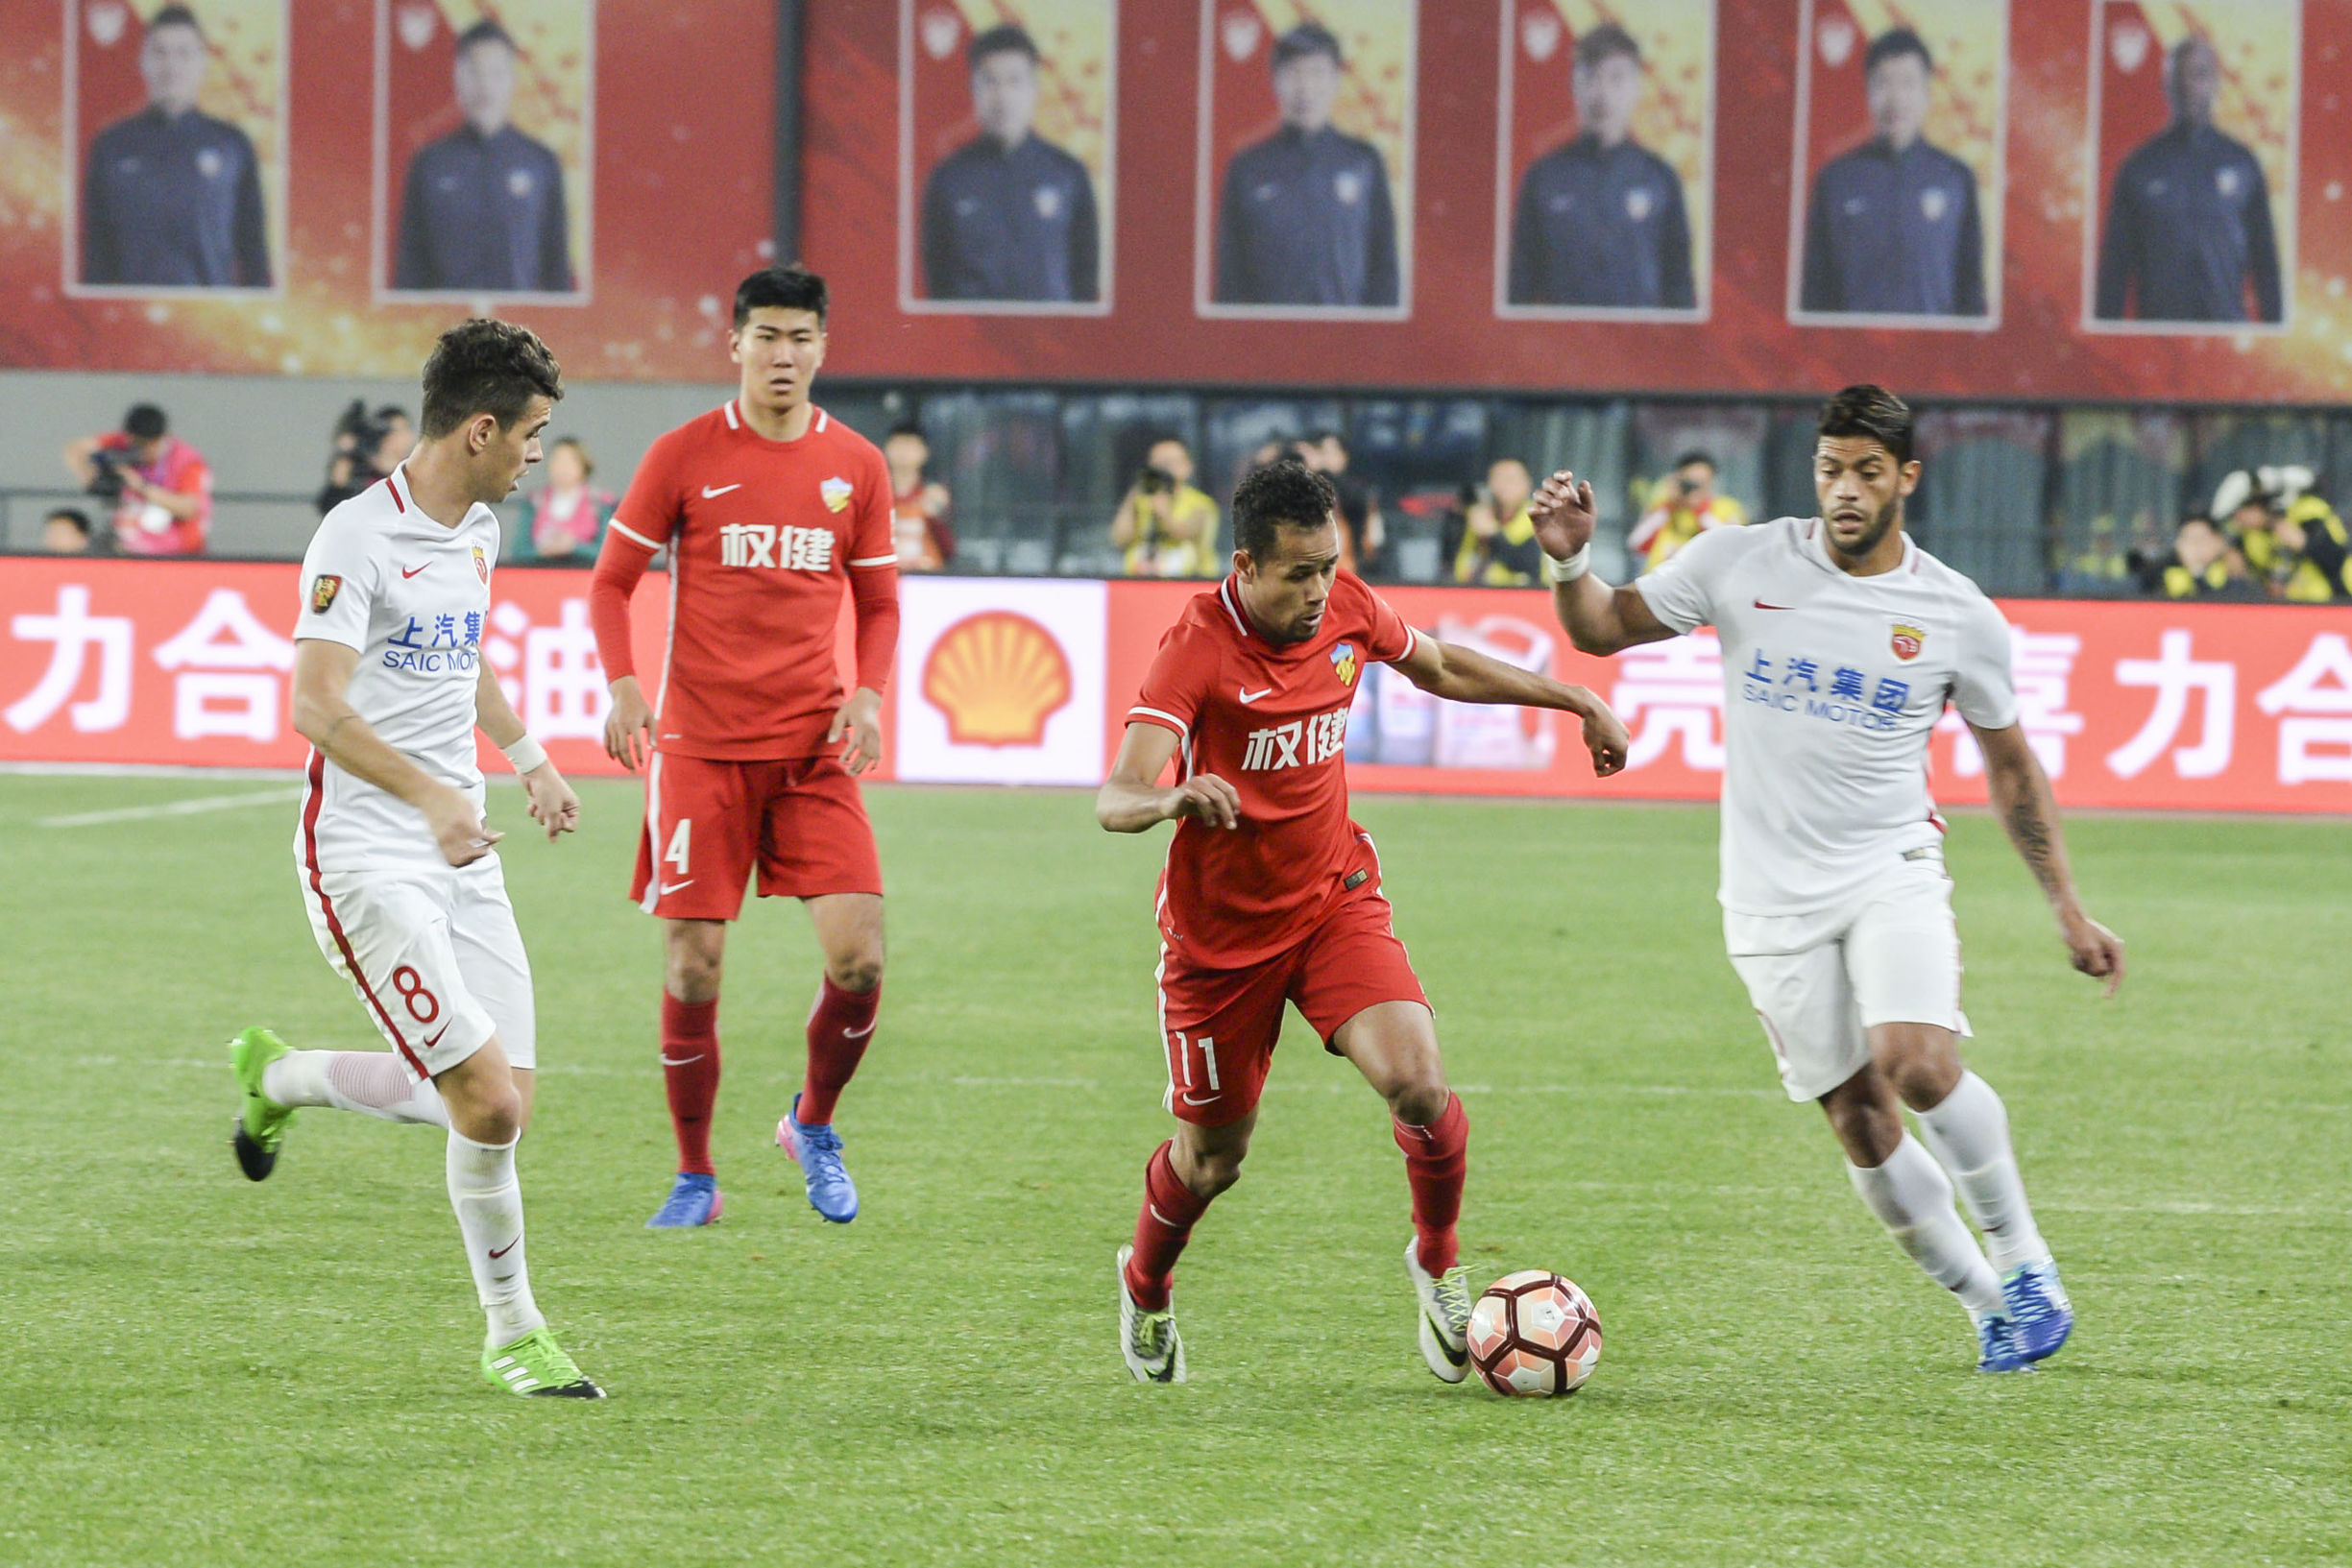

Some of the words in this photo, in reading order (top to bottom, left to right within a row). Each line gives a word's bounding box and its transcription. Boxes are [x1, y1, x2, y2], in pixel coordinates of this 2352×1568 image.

[719, 522, 836, 572] 权健
[387, 610, 489, 650] 上汽集
[382, 650, 441, 672] SAIC
[1744, 648, 1910, 713] 上汽集团
[1743, 683, 1798, 712] SAIC
[1241, 707, 1348, 771] 权健
[664, 818, 691, 875] 4
[392, 965, 440, 1024] 8
[1175, 1031, 1221, 1091] 11
